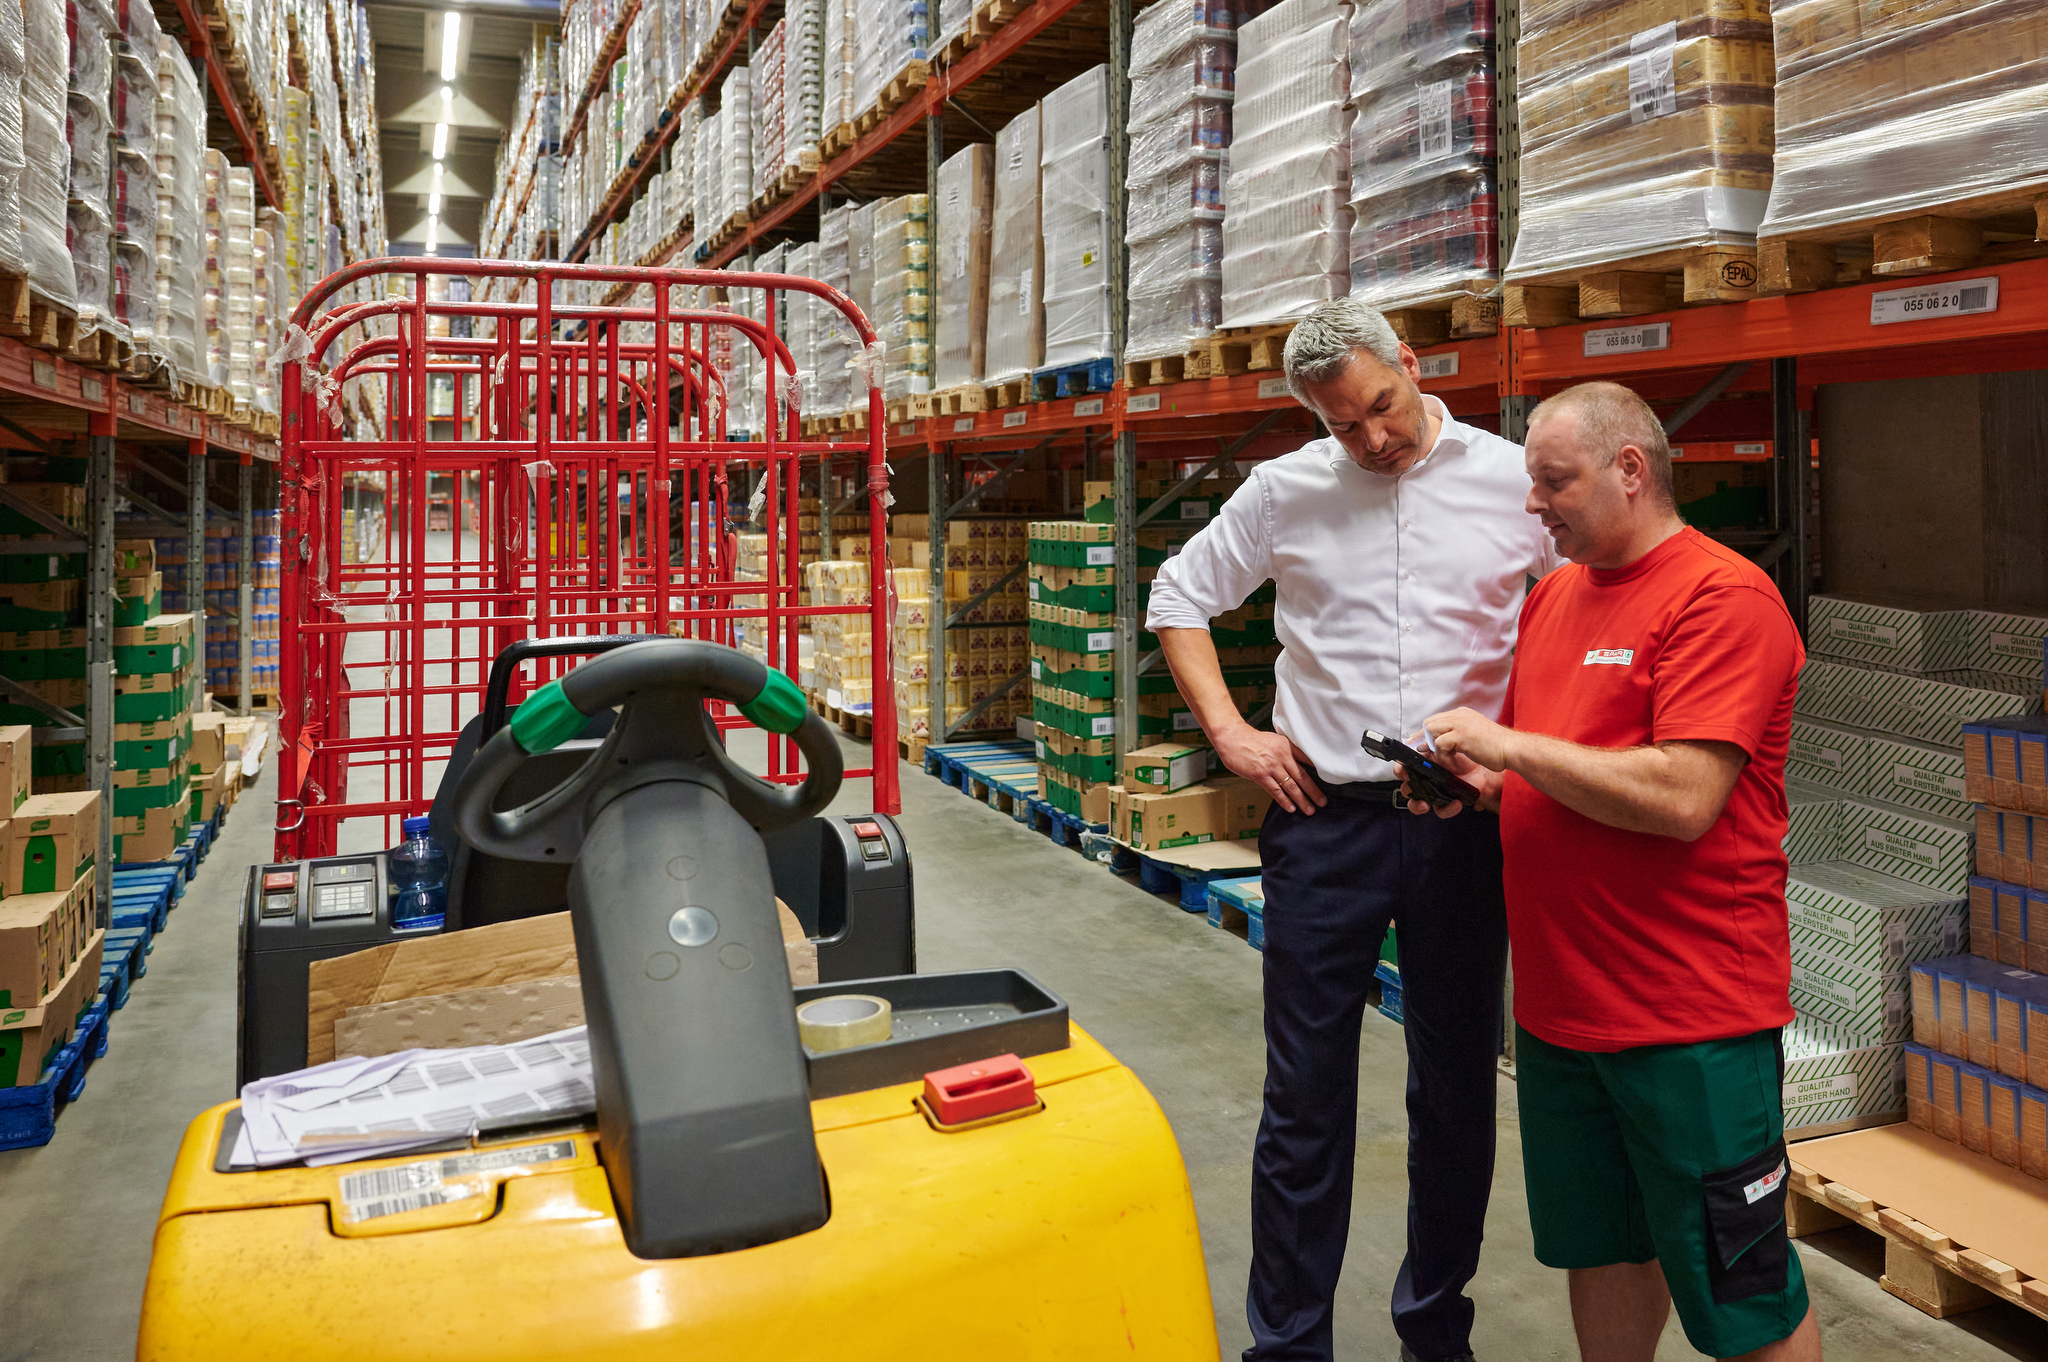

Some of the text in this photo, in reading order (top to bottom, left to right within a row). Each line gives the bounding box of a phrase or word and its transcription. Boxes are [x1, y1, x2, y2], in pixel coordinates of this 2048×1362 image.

[1728, 266, 1752, 280] EPAL
[1904, 299, 1924, 312] 055
[1927, 297, 1939, 310] 06
[1942, 296, 1949, 307] 2
[1952, 295, 1959, 306] 0
[1606, 336, 1619, 347] 055
[1621, 335, 1630, 346] 06
[1631, 335, 1636, 345] 3
[1637, 334, 1642, 344] 0
[1847, 621, 1876, 634] QUALITÄT
[1834, 628, 1891, 645] AUS ERSTER HAND
[1995, 644, 2010, 653] AUS
[2011, 646, 2038, 657] ERSTER
[1795, 742, 1823, 755] QUALITÄT
[1796, 751, 1819, 763] ERSTER
[1819, 757, 1836, 768] HAND
[1913, 770, 1946, 784] QUALITÄT
[1898, 776, 1962, 798] AUS ERSTER HAND
[1885, 834, 1917, 850] QUALITÄT
[1870, 840, 1933, 865] AUS ERSTER HAND
[1802, 907, 1834, 924] QUALITÄT
[1803, 916, 1829, 932] ERSTER
[1829, 926, 1849, 940] HAND
[1803, 971, 1835, 990] QUALITÄT
[1804, 981, 1829, 998] ERSTER
[1831, 991, 1850, 1006] HAND
[1797, 1080, 1833, 1093] QUALITÄT
[1798, 1091, 1828, 1104] ERSTER
[1829, 1087, 1851, 1098] HAND
